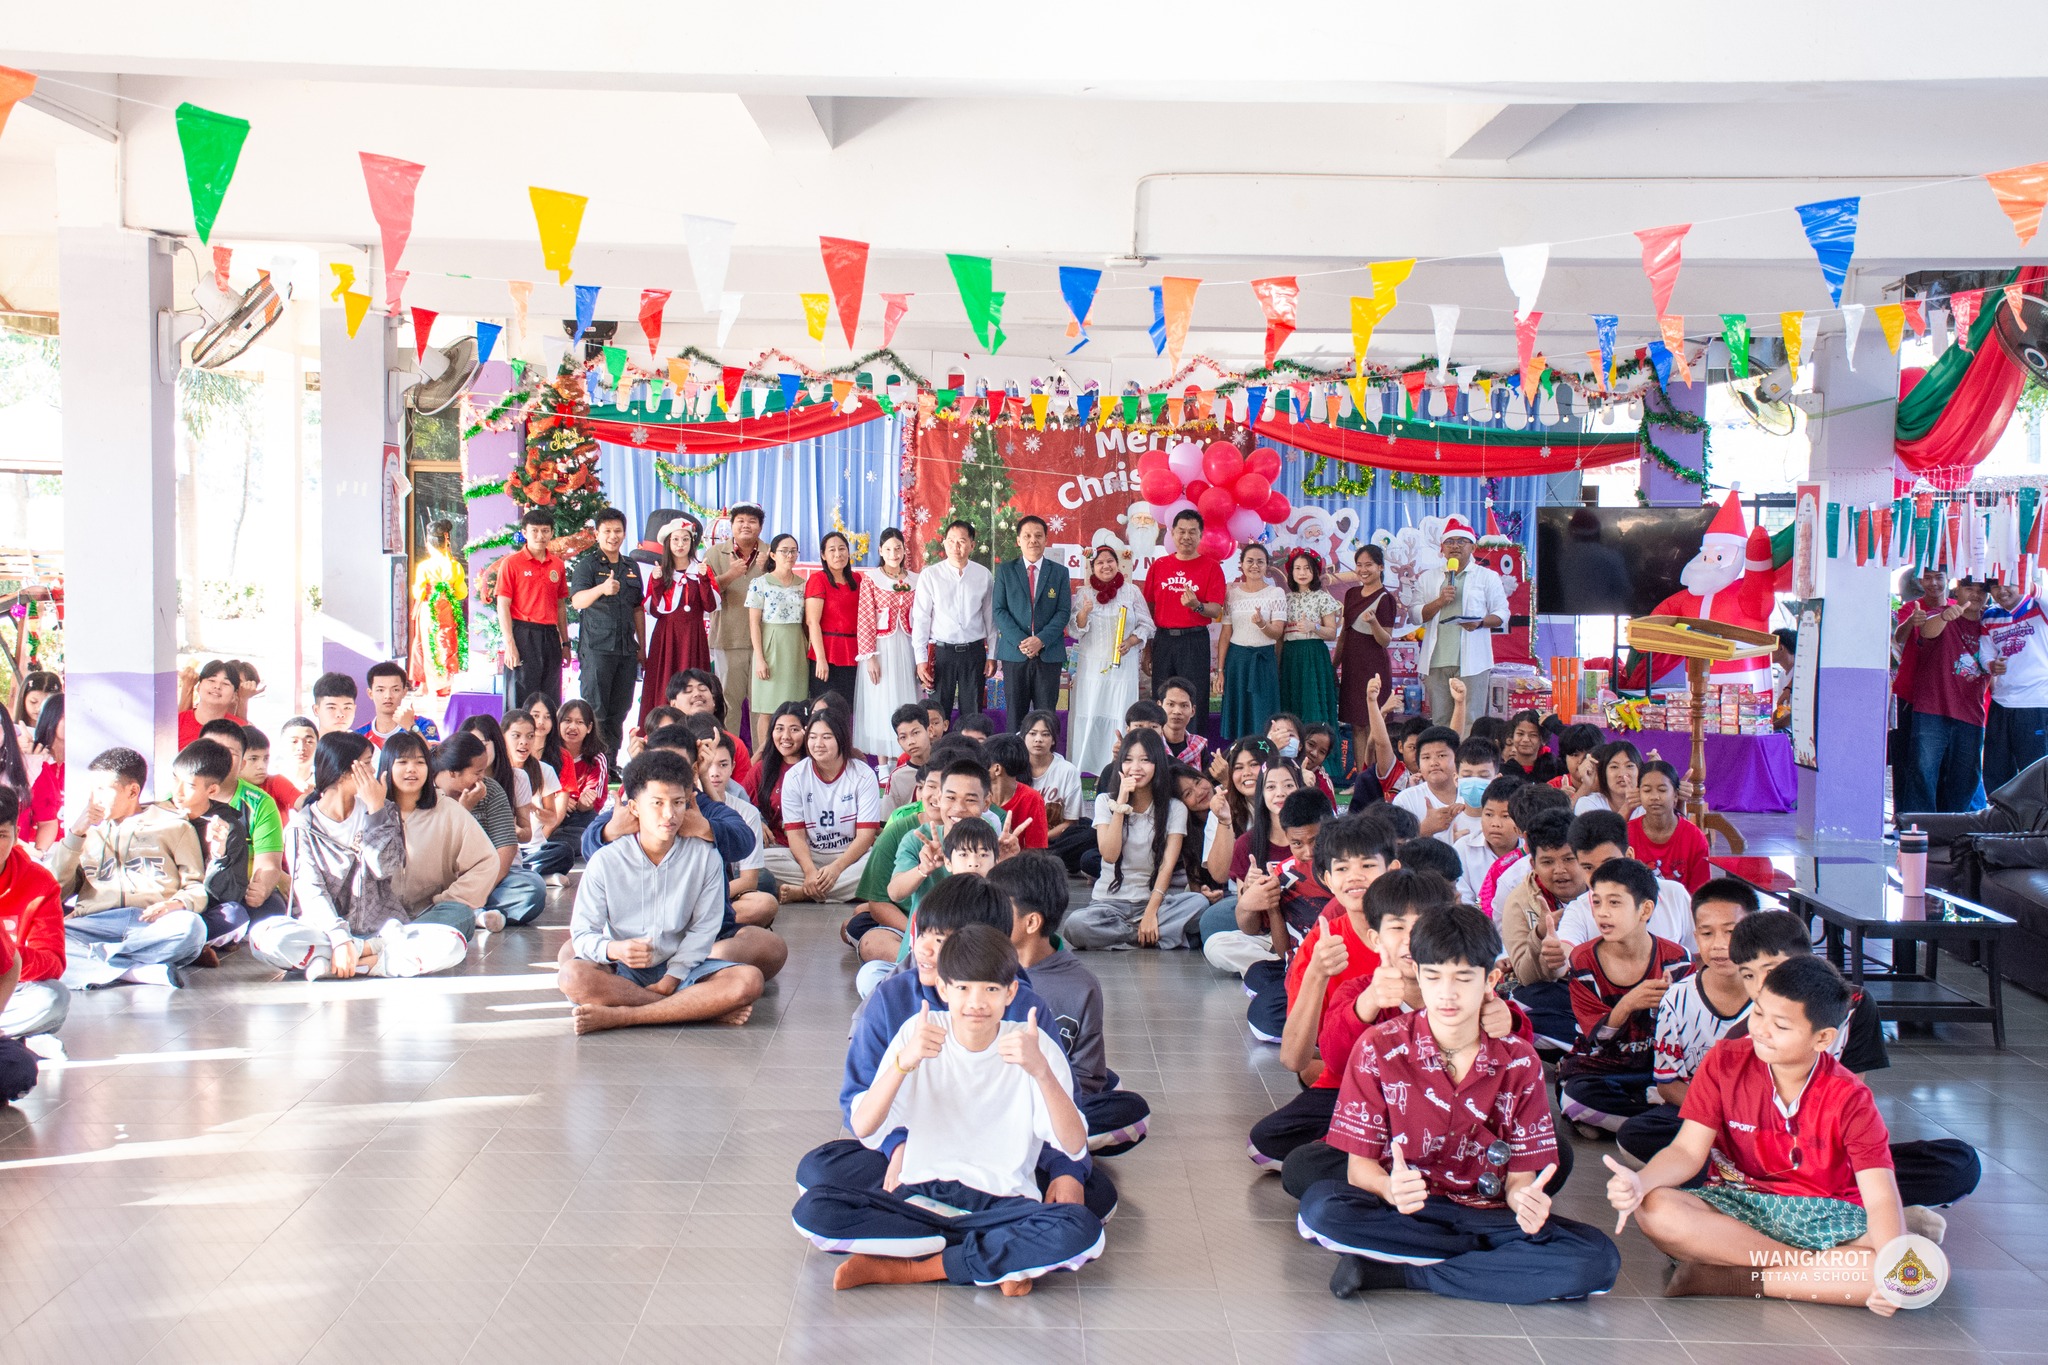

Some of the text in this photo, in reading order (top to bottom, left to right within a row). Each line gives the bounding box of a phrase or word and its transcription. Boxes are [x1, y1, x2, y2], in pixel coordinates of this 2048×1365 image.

[1058, 461, 1141, 510] Chris
[1161, 576, 1200, 593] ADIDAS
[819, 810, 835, 827] 23
[1728, 1120, 1756, 1132] SPORT
